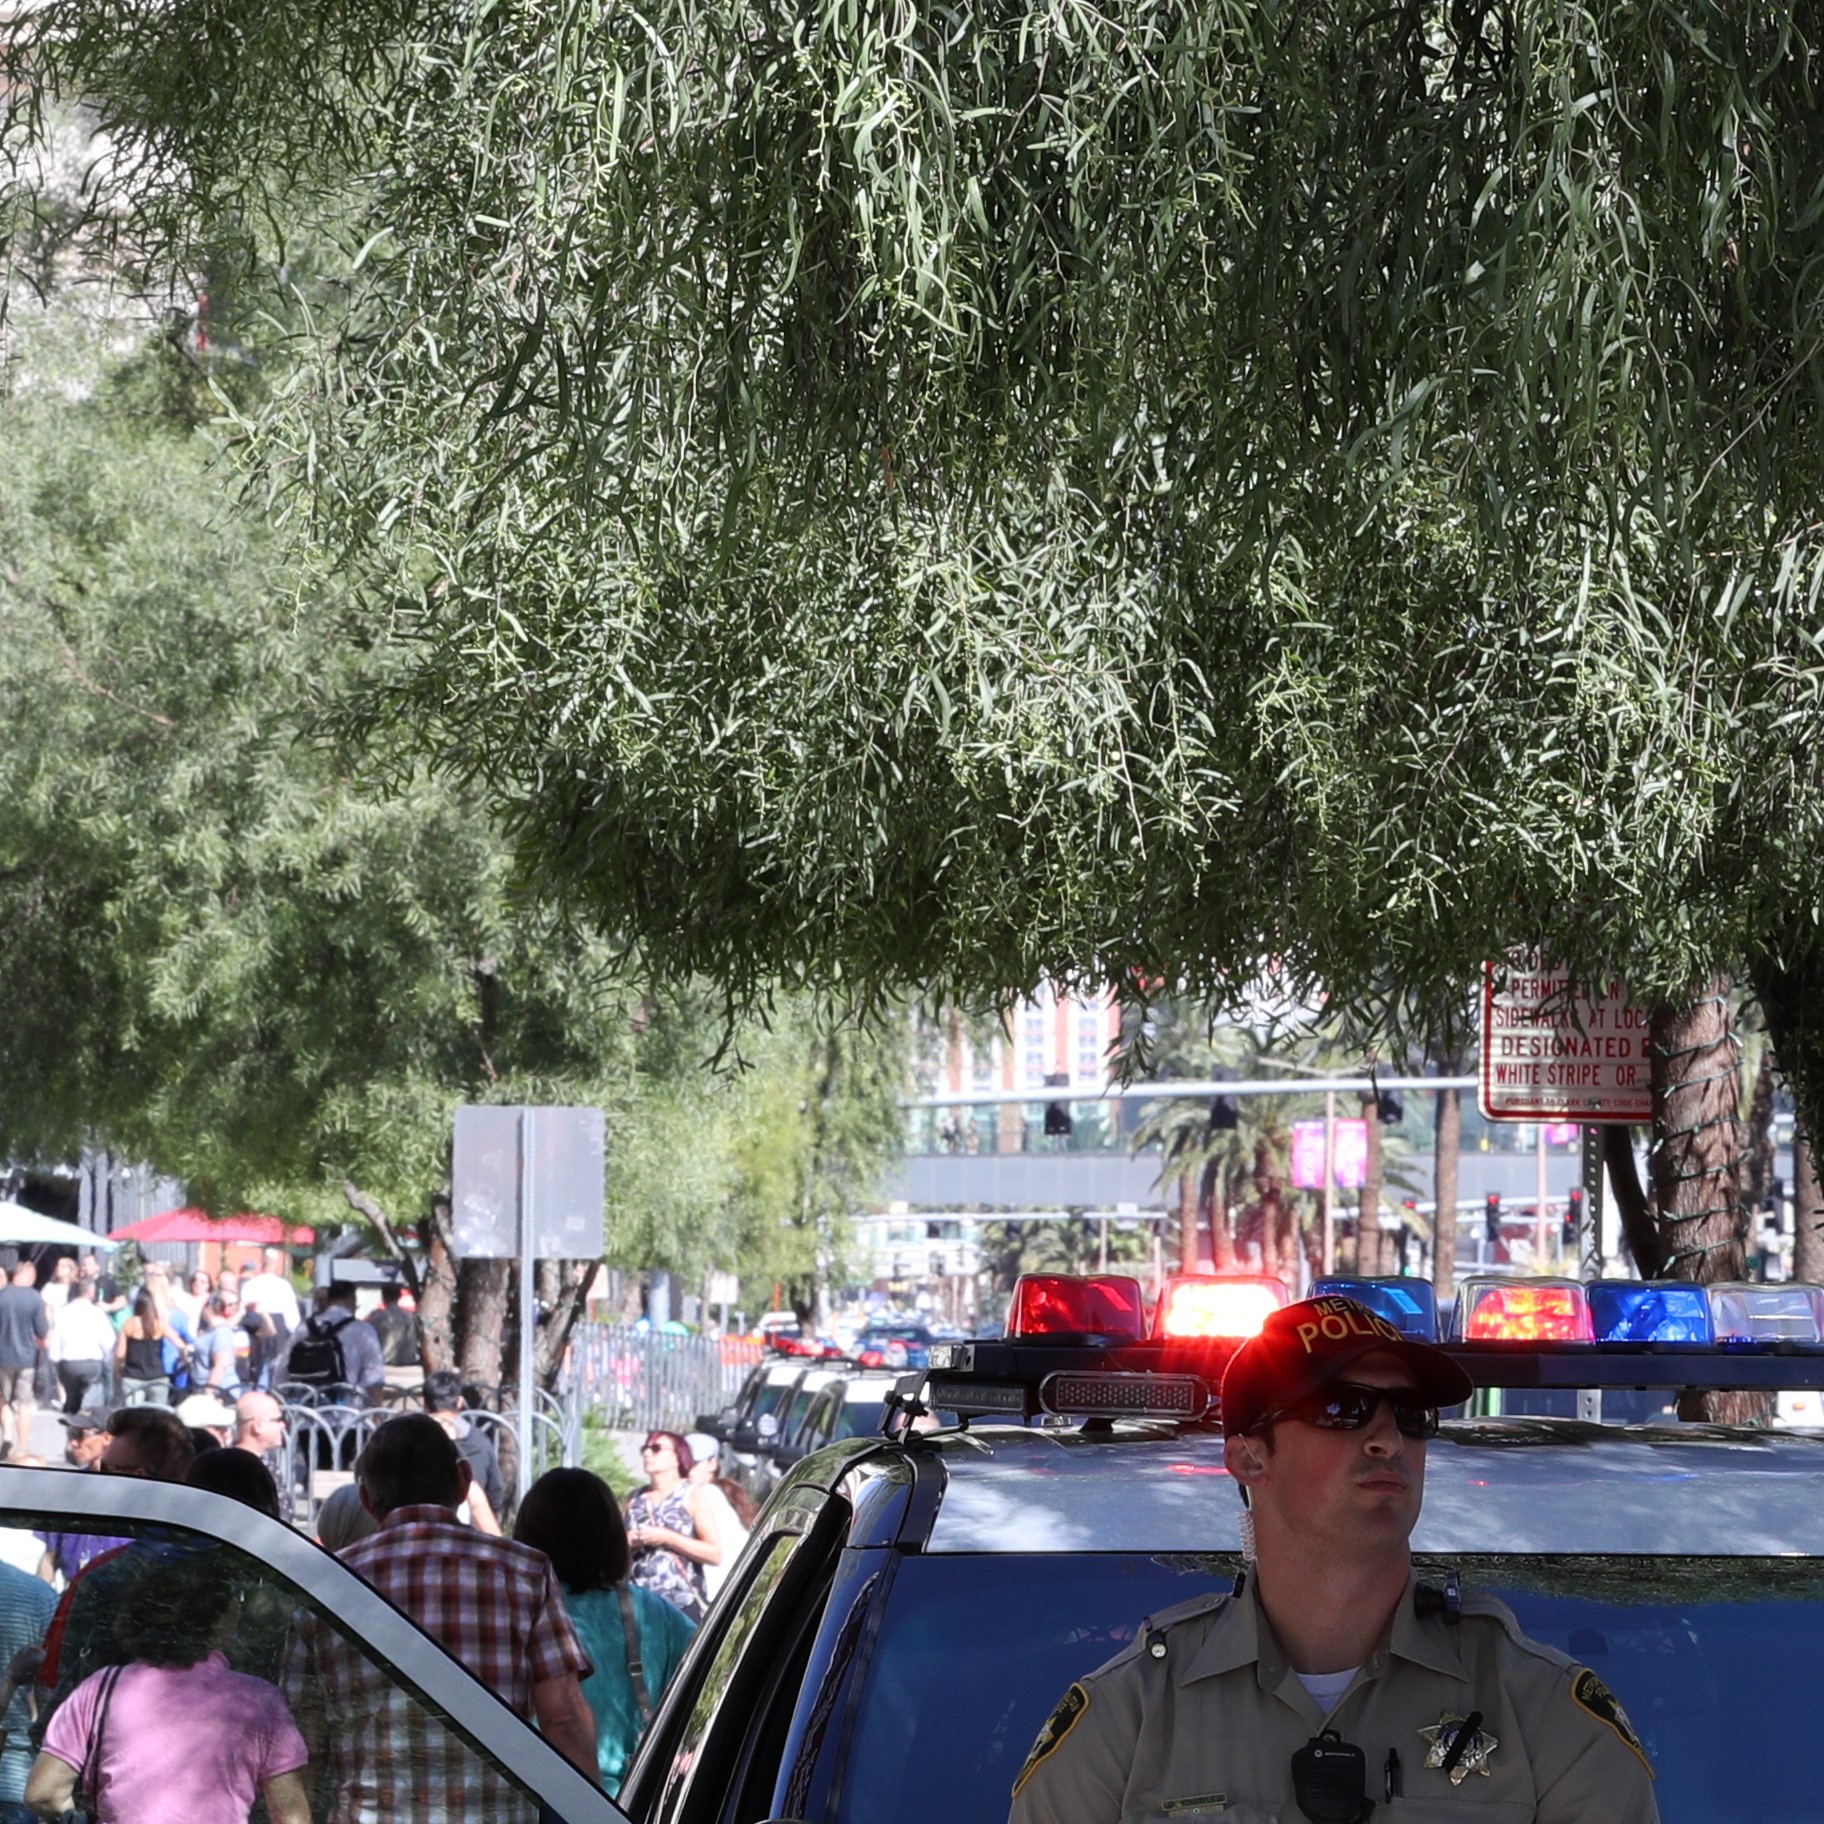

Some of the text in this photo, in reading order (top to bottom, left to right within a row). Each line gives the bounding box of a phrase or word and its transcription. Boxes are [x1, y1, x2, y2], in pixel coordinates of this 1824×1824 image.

[1511, 978, 1591, 1000] PERMITED
[1496, 1006, 1650, 1029] SIDEWALK AT LOC
[1502, 1036, 1631, 1058] DESIGNATED
[1496, 1064, 1636, 1087] WHITE STRIPE OR
